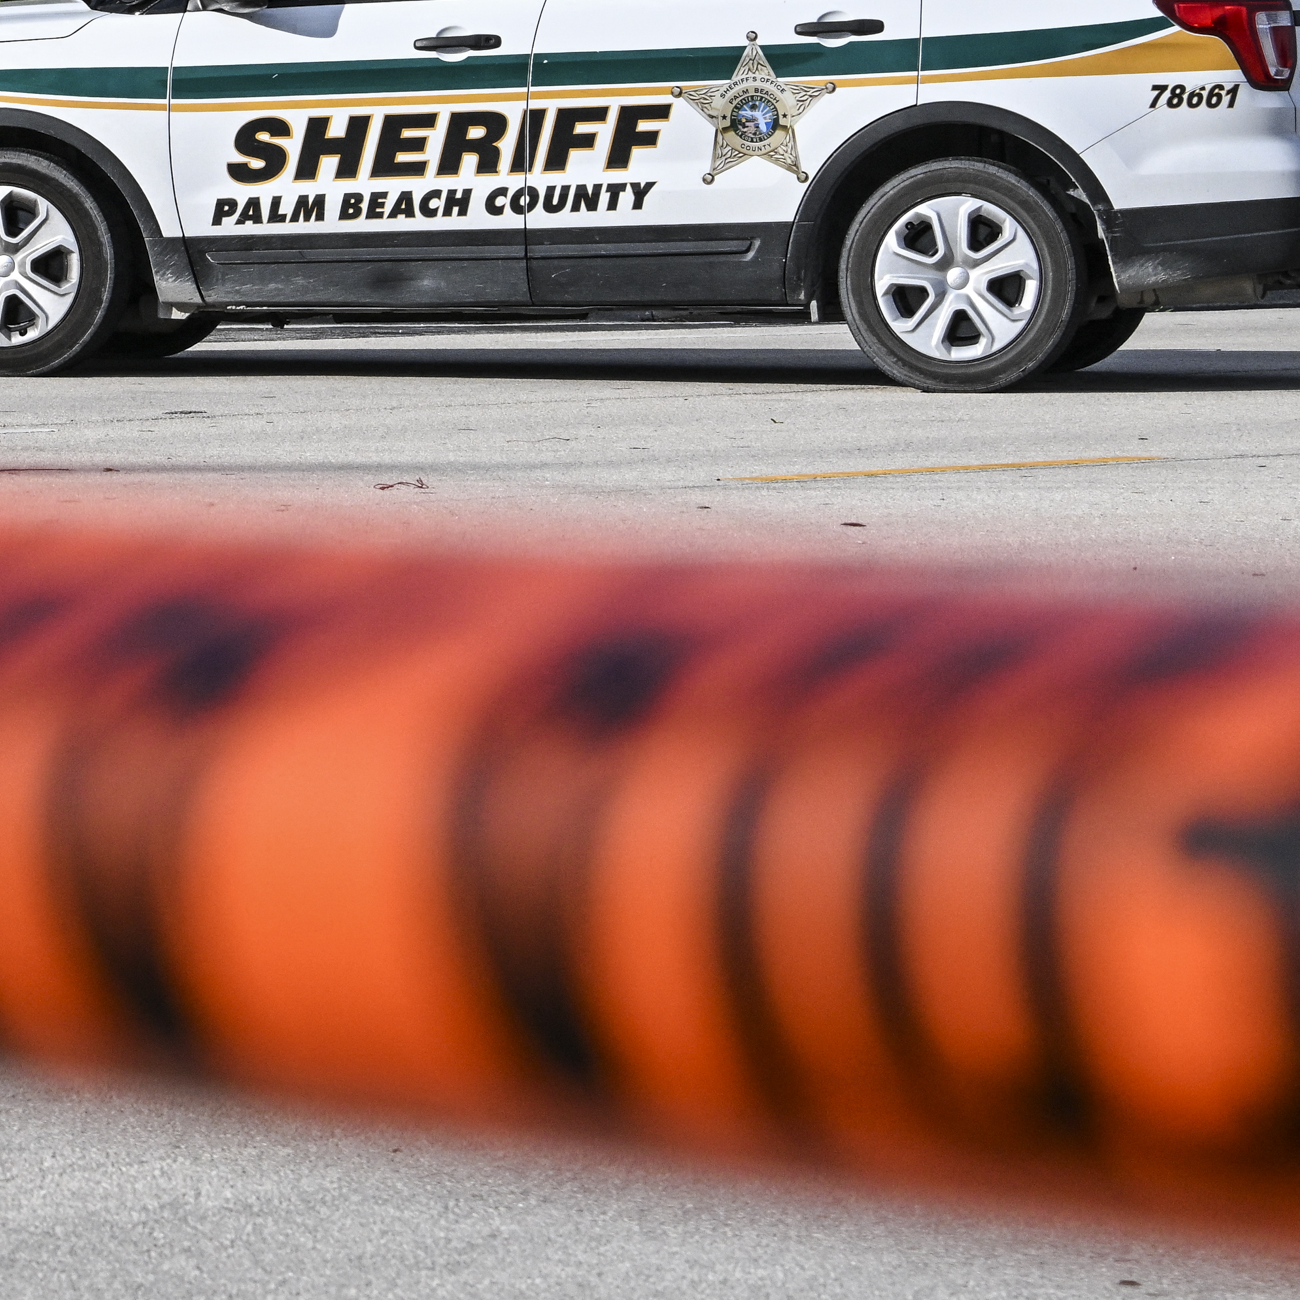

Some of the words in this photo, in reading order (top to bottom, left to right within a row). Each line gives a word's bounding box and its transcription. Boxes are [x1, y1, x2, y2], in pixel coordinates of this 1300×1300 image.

[720, 76, 757, 99] SHERIFF'S
[760, 77, 786, 94] OFFICE
[729, 89, 749, 105] PALM
[754, 88, 780, 104] BEACH
[1149, 84, 1241, 109] 78661
[761, 97, 778, 118] FLORIDA
[225, 103, 673, 186] SHERIFF
[740, 143, 772, 152] COUNTY
[211, 193, 326, 227] PALM
[338, 188, 473, 221] BEACH
[484, 181, 657, 217] COUNTY
